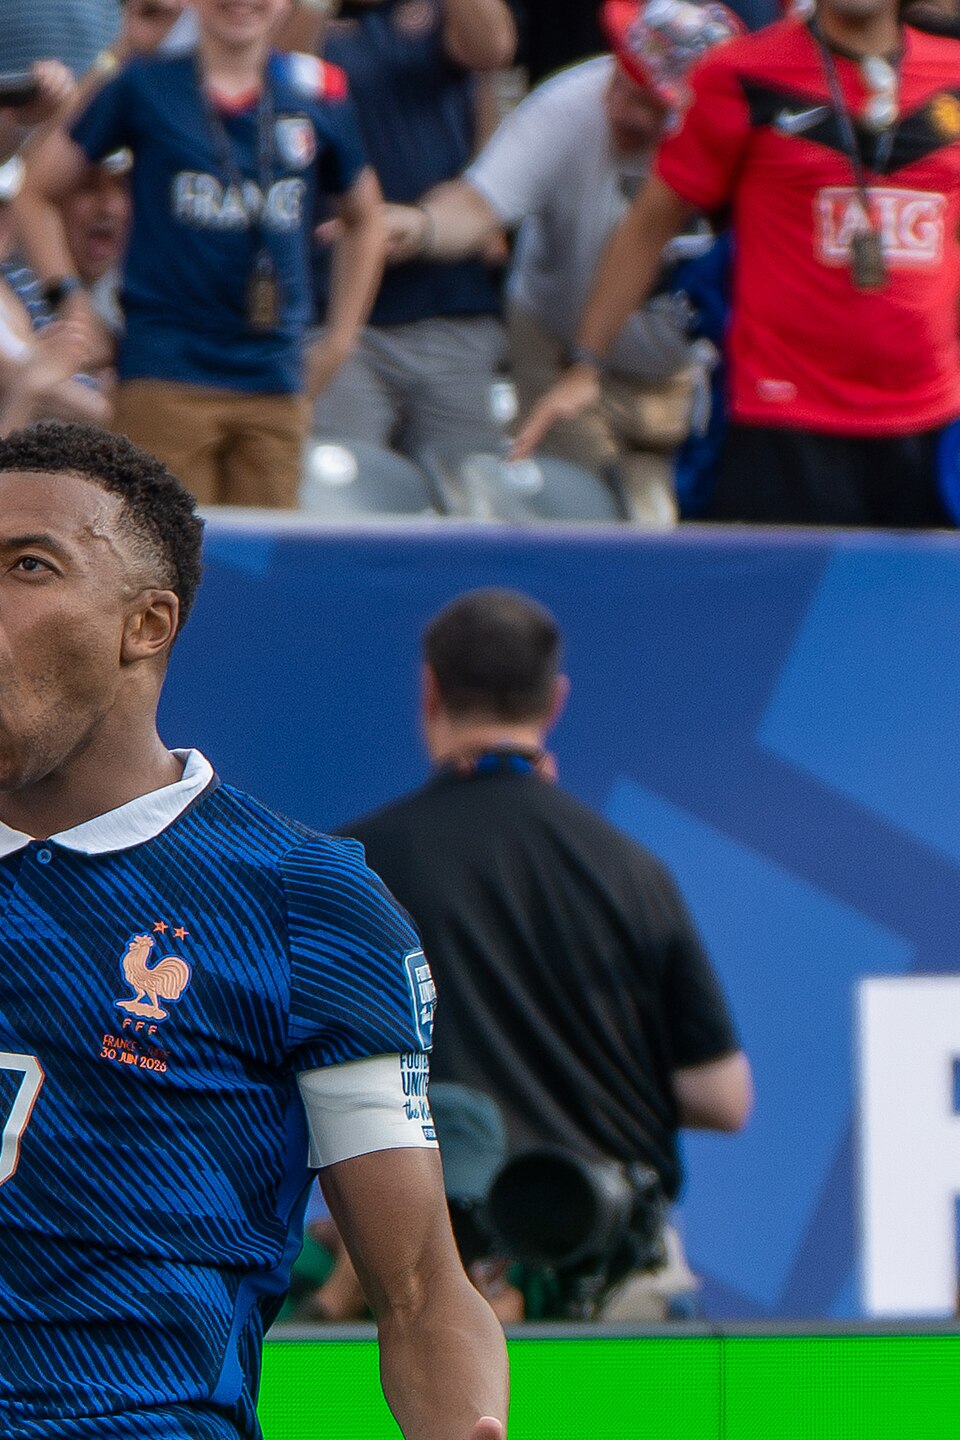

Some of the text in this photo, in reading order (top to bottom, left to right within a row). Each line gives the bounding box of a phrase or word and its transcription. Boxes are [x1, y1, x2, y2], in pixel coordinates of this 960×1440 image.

[833, 195, 941, 250] AIG
[100, 1046, 117, 1060] 30
[139, 1056, 167, 1073] 2026
